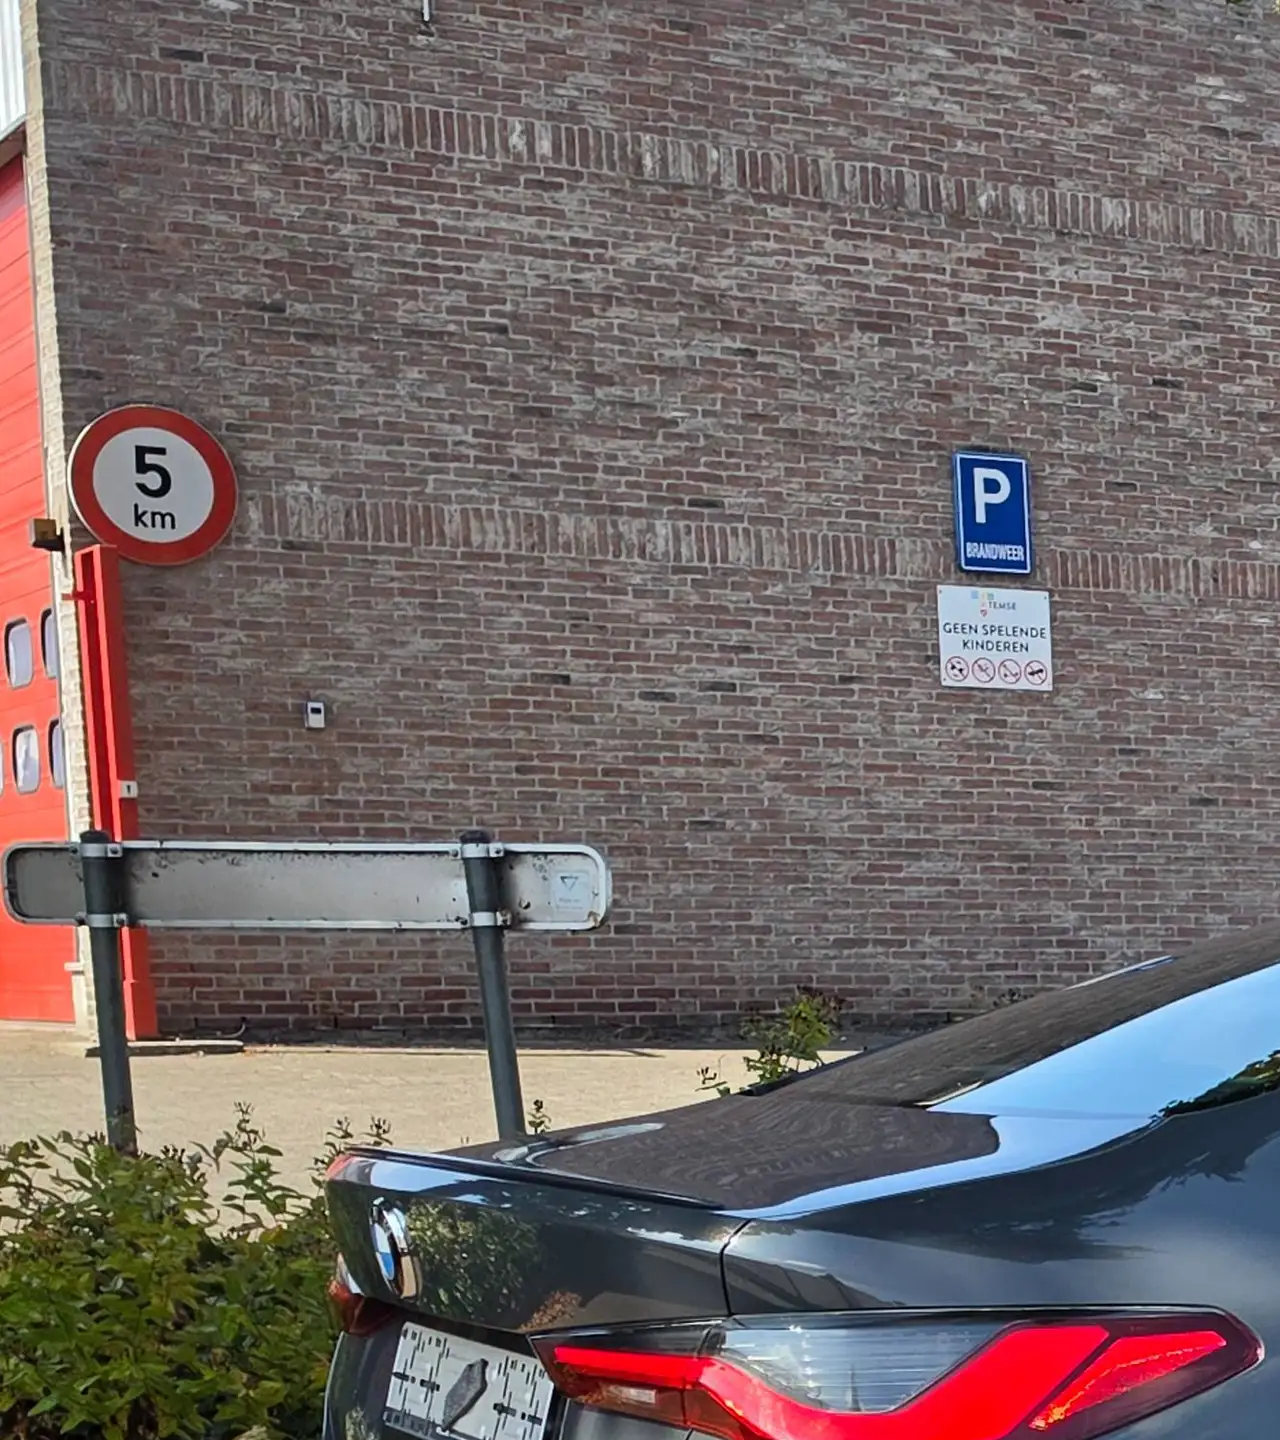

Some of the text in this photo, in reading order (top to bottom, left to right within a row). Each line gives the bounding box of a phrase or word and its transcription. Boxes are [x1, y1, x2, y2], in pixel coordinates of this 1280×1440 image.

[135, 445, 172, 498] 5
[972, 467, 1011, 524] P
[133, 503, 176, 530] km
[966, 541, 1025, 561] BRANDWEER
[988, 601, 1017, 611] TEMSE
[942, 622, 1047, 639] GEEN SPELENDE
[961, 639, 1029, 653] KINDEREN
